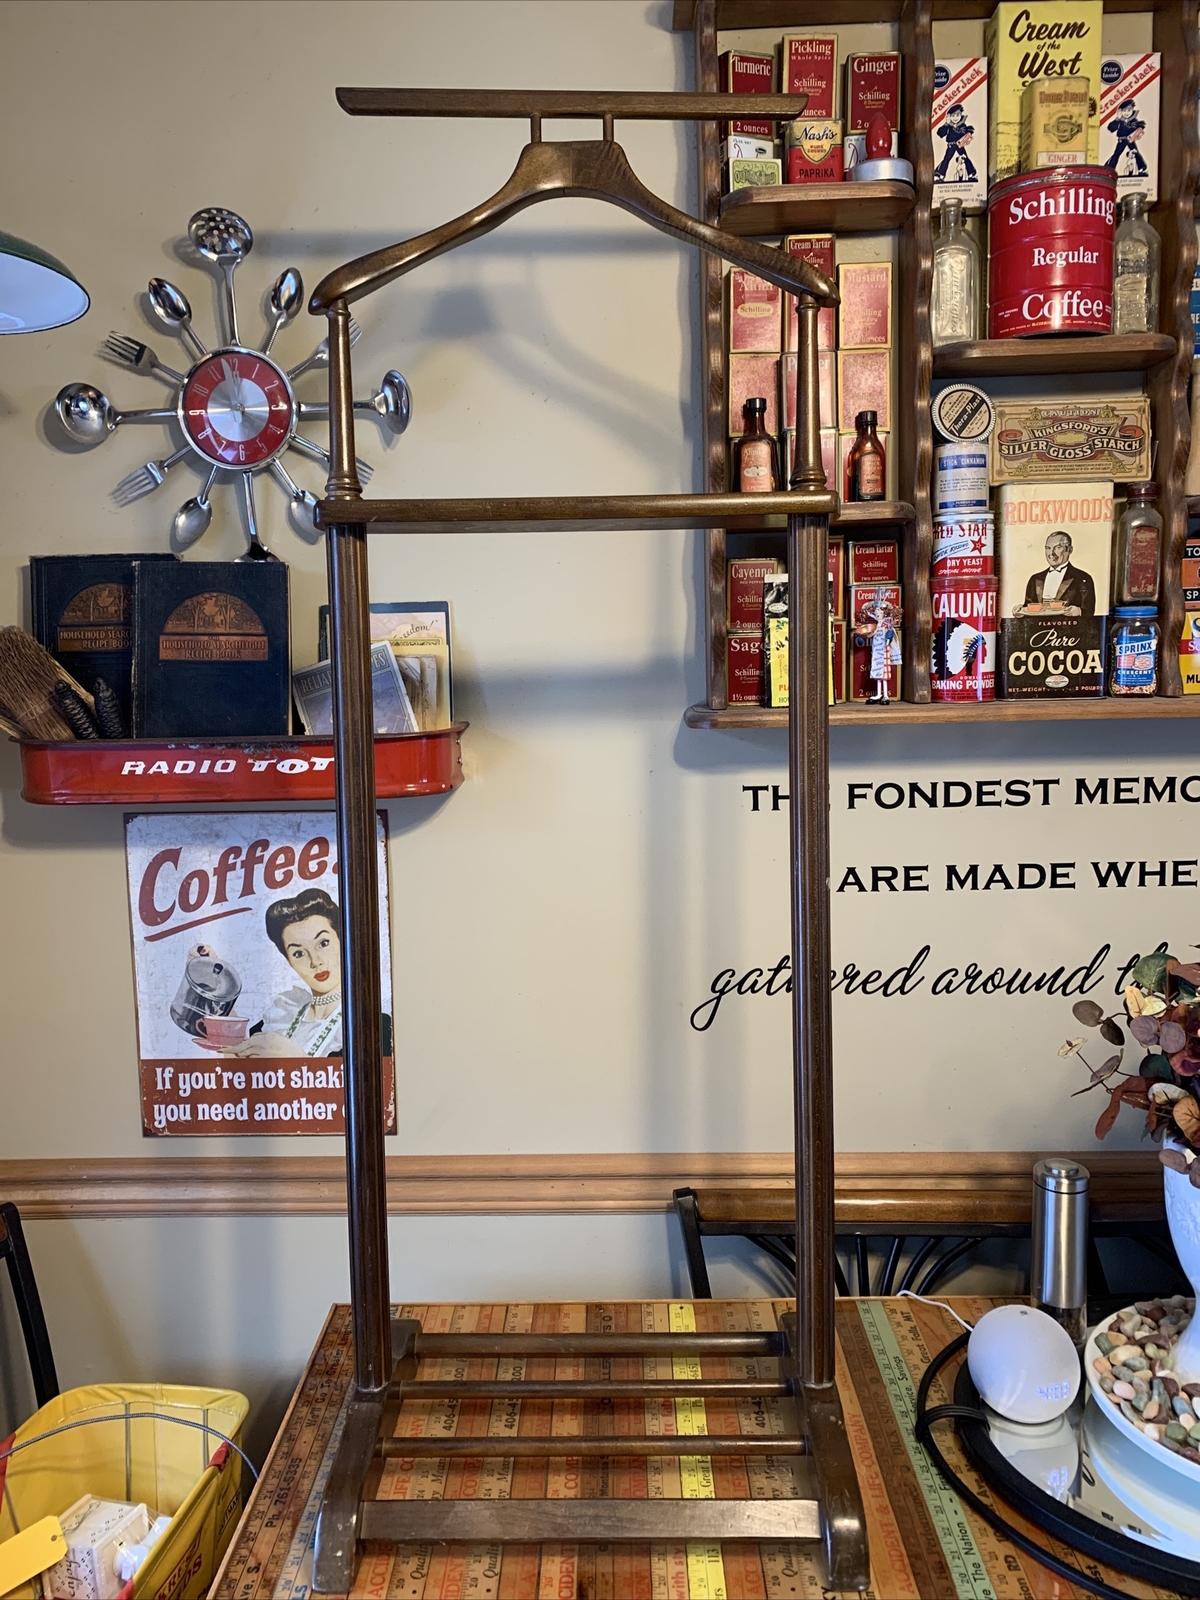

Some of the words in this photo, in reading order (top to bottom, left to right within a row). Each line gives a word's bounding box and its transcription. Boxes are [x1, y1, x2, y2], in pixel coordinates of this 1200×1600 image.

[1008, 9, 1090, 43] Cream
[791, 42, 832, 56] Pickling
[1036, 42, 1046, 51] of
[1046, 41, 1061, 50] the
[733, 56, 771, 76] Turmeric
[853, 58, 896, 74] Ginger
[1018, 51, 1082, 79] West
[1133, 62, 1156, 84] Jack
[794, 78, 826, 88] Schilling
[961, 66, 983, 90] Jack
[858, 92, 890, 100] Schilling
[736, 122, 740, 130] 2
[743, 124, 768, 134] ounces
[796, 126, 838, 140] Nash's
[856, 120, 862, 128] 2
[1048, 154, 1077, 163] GINGER
[800, 168, 834, 178] PAPRIKA
[1008, 188, 1114, 226] Schilling
[790, 240, 811, 249] Cream
[811, 239, 832, 248] Tartar
[1032, 246, 1100, 268] Regular
[1022, 290, 1104, 320] Coffee
[264, 380, 278, 392] 2
[948, 395, 982, 436] Thera-Plast
[198, 428, 212, 440] 8
[1033, 422, 1108, 438] KINGSFORD'S
[239, 444, 246, 461] 6
[256, 438, 268, 453] 5
[1001, 441, 1047, 455] SILVER
[1050, 446, 1092, 458] GLOSS
[1094, 438, 1140, 450] STARCH
[1004, 495, 1114, 526] ROCKWOOD'S
[958, 523, 987, 538] STAR
[855, 544, 875, 554] Cream
[876, 545, 894, 554] Tartar
[962, 558, 983, 566] YEAST
[732, 565, 773, 580] Cayenne
[737, 595, 763, 604] Schillin
[932, 592, 996, 618] CALUMET
[736, 620, 740, 628] 2
[60, 631, 106, 640] HOUSEHOLD
[108, 630, 132, 639] SEARC
[82, 640, 108, 648] RECIPE
[1030, 628, 1080, 648] Pure
[163, 640, 210, 650] HOUSEHOLD
[211, 640, 266, 650] SEARCHLIGHT
[1118, 642, 1152, 654] SPRINX
[185, 650, 212, 658] RECIPE
[216, 650, 241, 659] BOOK
[1008, 650, 1104, 676] COCOA
[932, 680, 963, 690] BAKING
[120, 760, 236, 775] RADIO
[247, 757, 335, 774] TOT
[742, 784, 791, 812] TH
[846, 778, 1060, 810] FONDEST
[1074, 775, 1200, 805] MEMO
[836, 864, 929, 894] ARE
[946, 862, 1076, 892] MADE
[1091, 859, 1198, 888] WHE
[690, 944, 932, 1032] gatred
[931, 943, 1112, 997] around
[156, 1067, 174, 1090] If
[178, 1067, 246, 1097] you're
[250, 1068, 286, 1089] not
[290, 1065, 345, 1089] shaki
[154, 1103, 192, 1128] you
[197, 1098, 248, 1121] need
[254, 1097, 338, 1121] another
[902, 1310, 915, 1323] MT
[910, 1324, 924, 1345] Falls,
[852, 1324, 875, 1370] CONGRESS
[920, 1345, 932, 1365] Great
[325, 1348, 344, 1376] Greater
[896, 1356, 908, 1382] Savings
[320, 1378, 332, 1389] To
[312, 1390, 326, 1404] Go
[304, 1407, 322, 1428] We'll
[847, 1413, 876, 1472] COMPANY
[274, 1457, 302, 1506] 761-5335
[564, 1456, 579, 1490] COMP
[699, 1466, 711, 1488] Great
[394, 1476, 410, 1500] LIFE
[866, 1473, 883, 1499] LIFE
[876, 1501, 891, 1515] &
[264, 1510, 282, 1528] Ph.
[958, 1520, 976, 1556] Nation
[708, 1548, 720, 1564] 113
[880, 1519, 915, 1595] ACCIDENT
[1004, 1554, 1022, 1572] RD
[246, 1562, 262, 1574] S.
[972, 1560, 987, 1583] The
[672, 1571, 686, 1600] with
